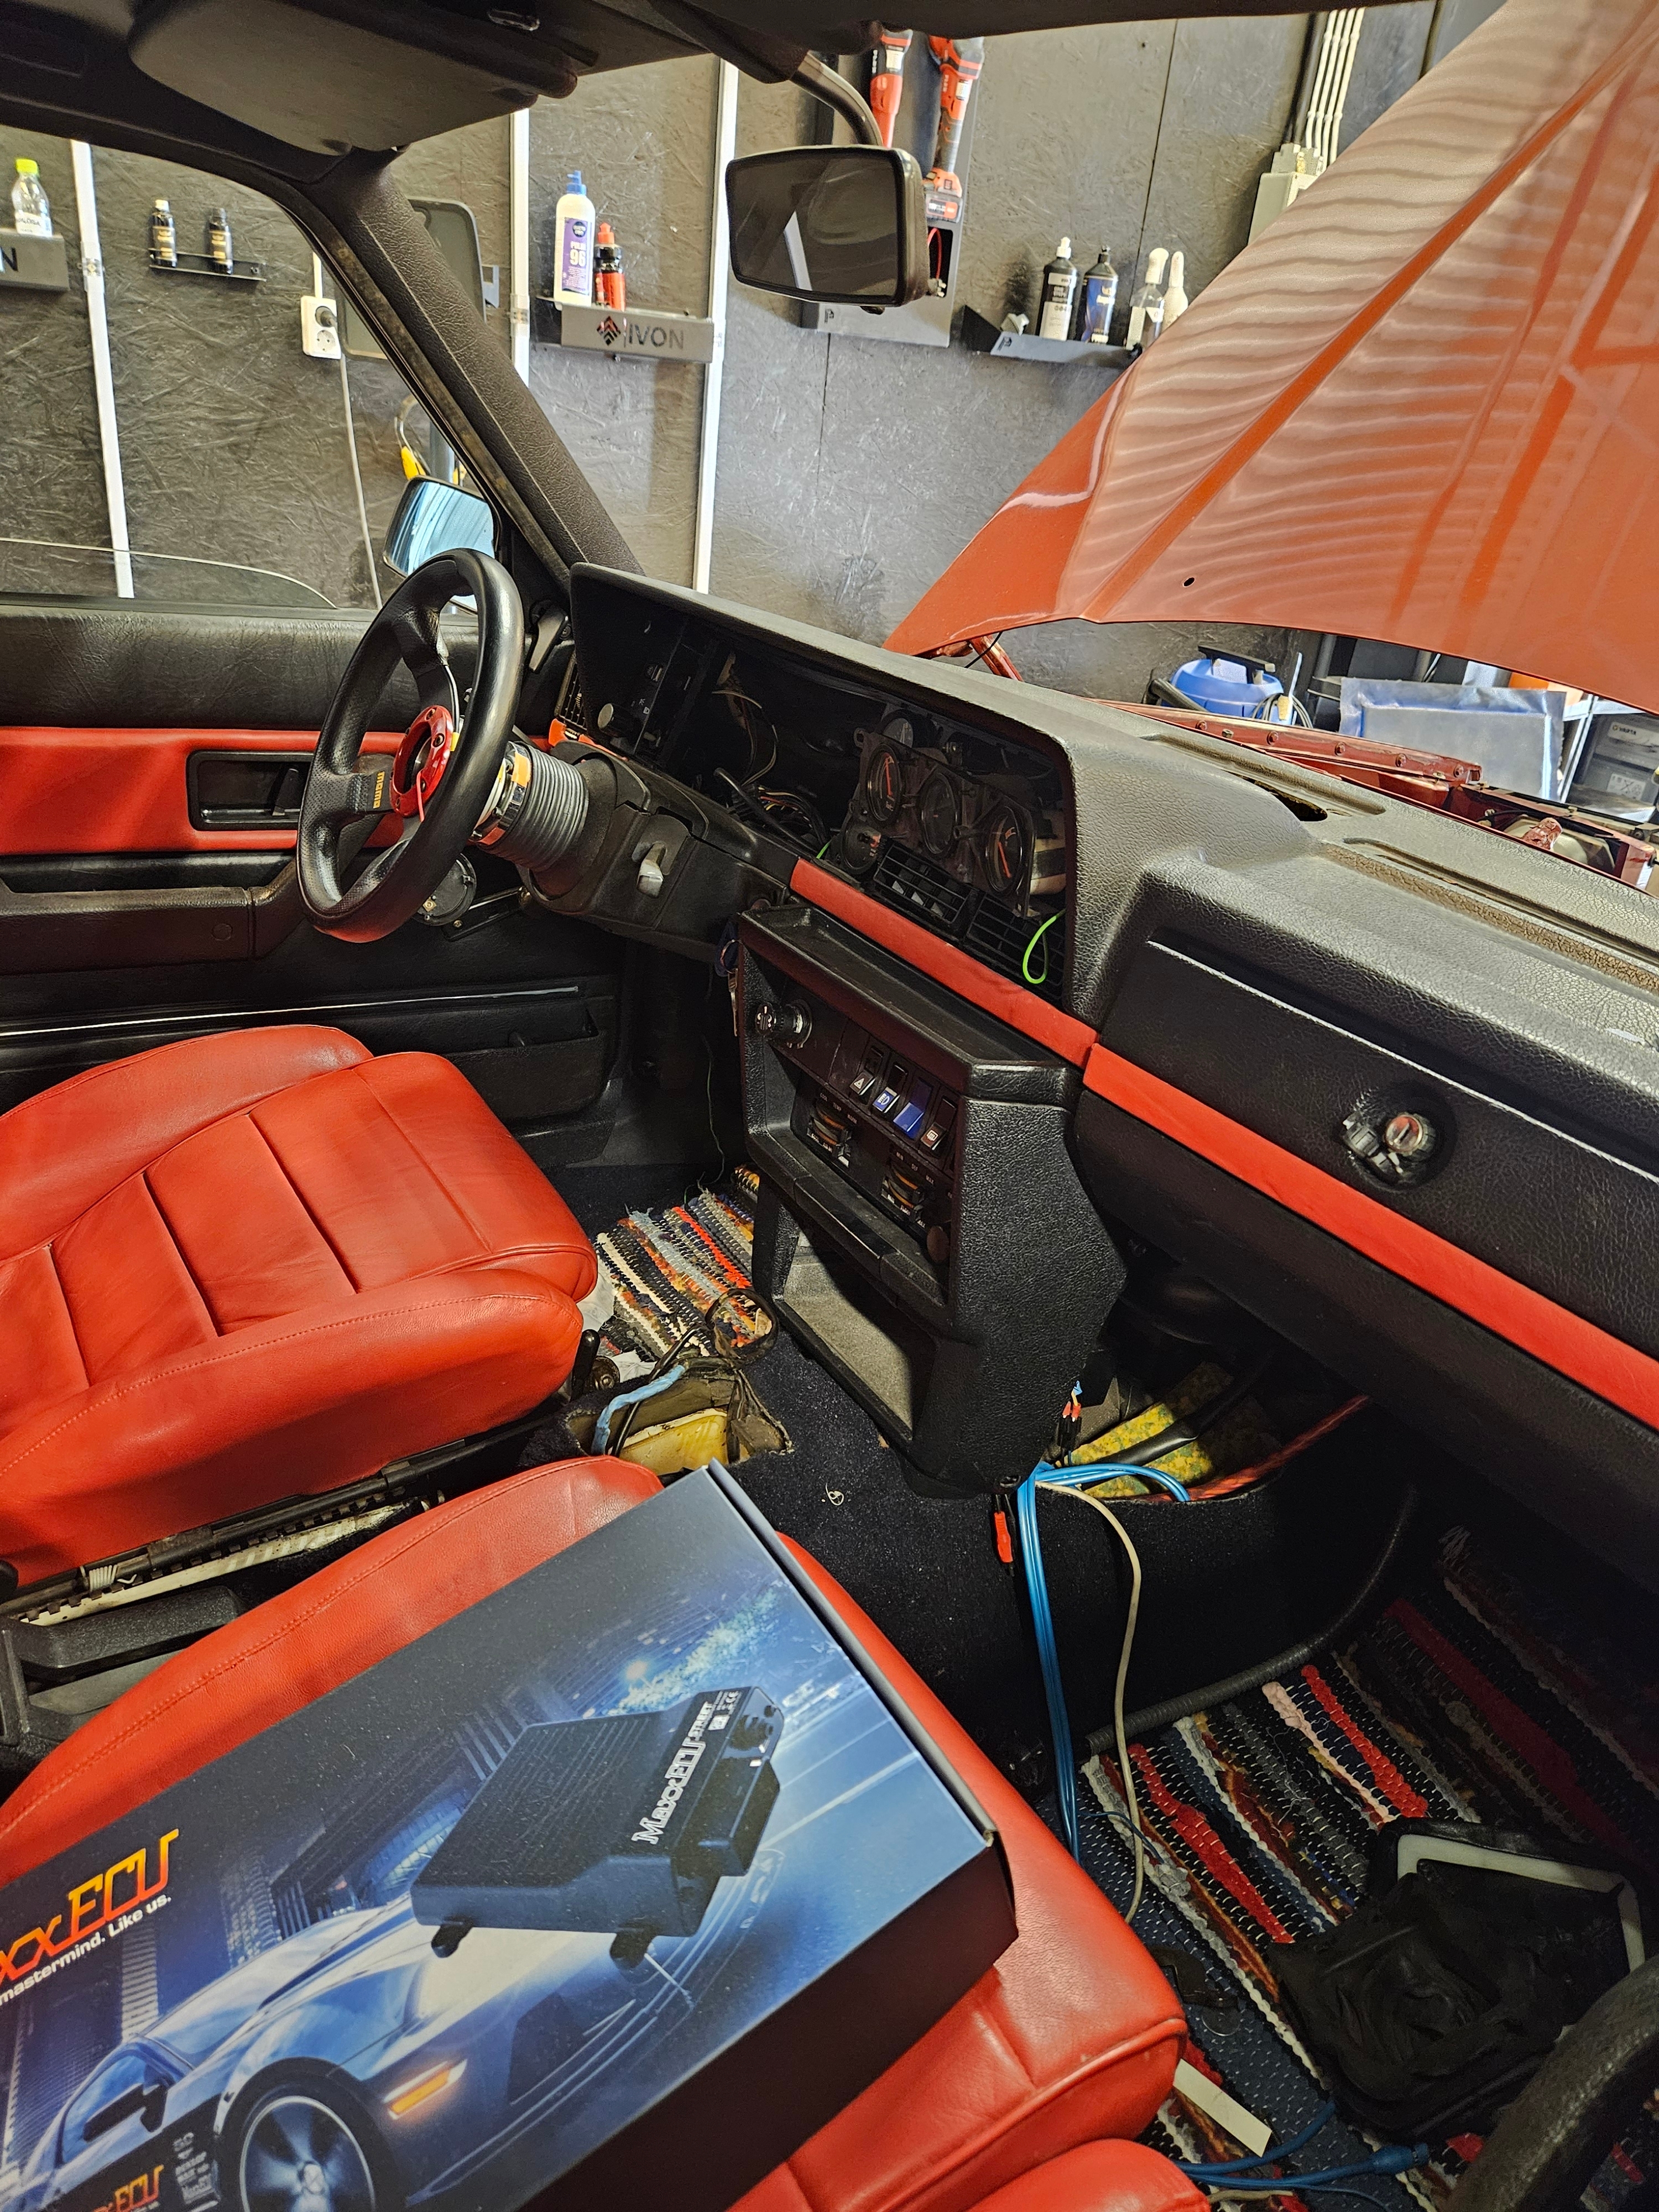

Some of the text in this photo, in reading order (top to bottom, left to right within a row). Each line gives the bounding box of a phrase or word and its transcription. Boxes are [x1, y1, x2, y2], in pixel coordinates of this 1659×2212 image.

[570, 249, 586, 267] 96
[629, 324, 684, 349] IVON
[631, 1736, 707, 1845] MaxxECU
[108, 1909, 143, 1937] Like
[145, 1894, 172, 1914] us.
